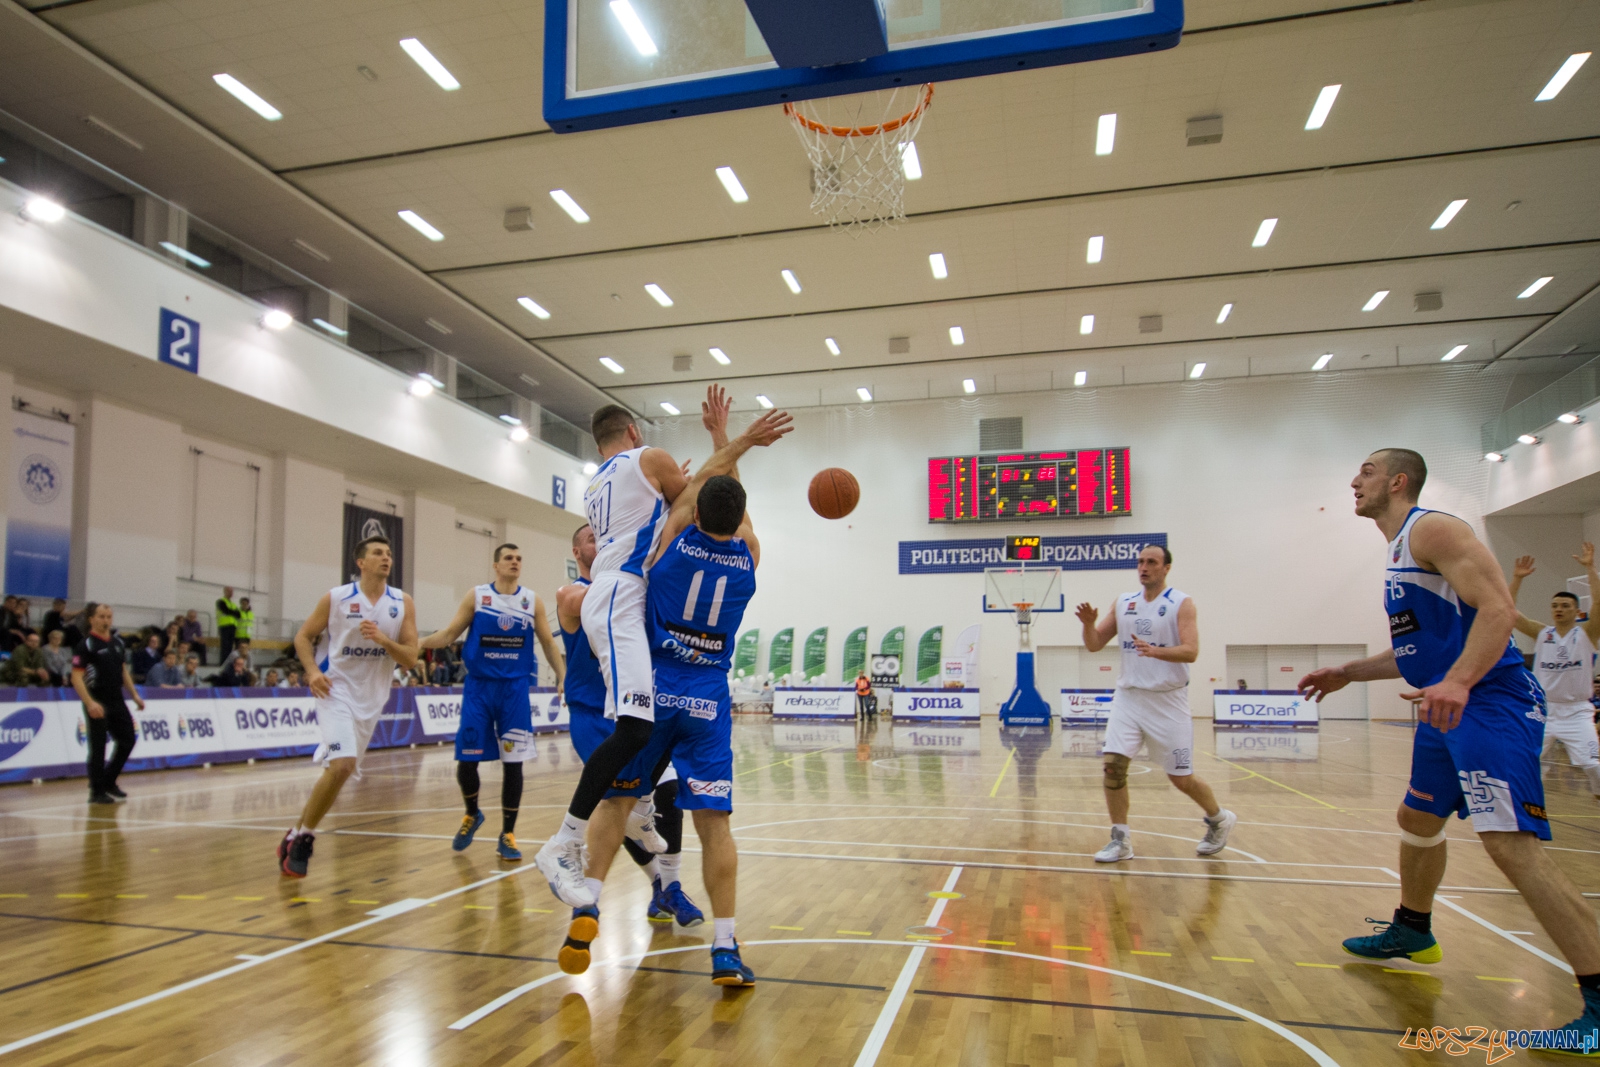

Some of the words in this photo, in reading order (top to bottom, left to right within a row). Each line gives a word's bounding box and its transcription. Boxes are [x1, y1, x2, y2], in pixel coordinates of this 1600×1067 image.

[170, 319, 191, 365] 2
[556, 479, 564, 505] 3
[911, 548, 1005, 565] POLITECHN
[1043, 541, 1148, 562] POZNAŃSK
[682, 570, 728, 627] 11
[1135, 618, 1152, 636] 12
[341, 646, 388, 657] BIOFAR
[1557, 645, 1568, 660] 2
[871, 655, 900, 676] GO
[428, 702, 462, 719] BIOFA
[632, 694, 651, 708] PBG
[657, 693, 718, 713] OPOLSKIE
[785, 695, 841, 708] rehasport
[185, 717, 213, 738] PBG
[235, 707, 319, 730] BIOFARM
[0, 726, 33, 742] trem
[140, 719, 170, 741] PBG
[1172, 748, 1190, 765] 12
[1467, 770, 1494, 804] 15
